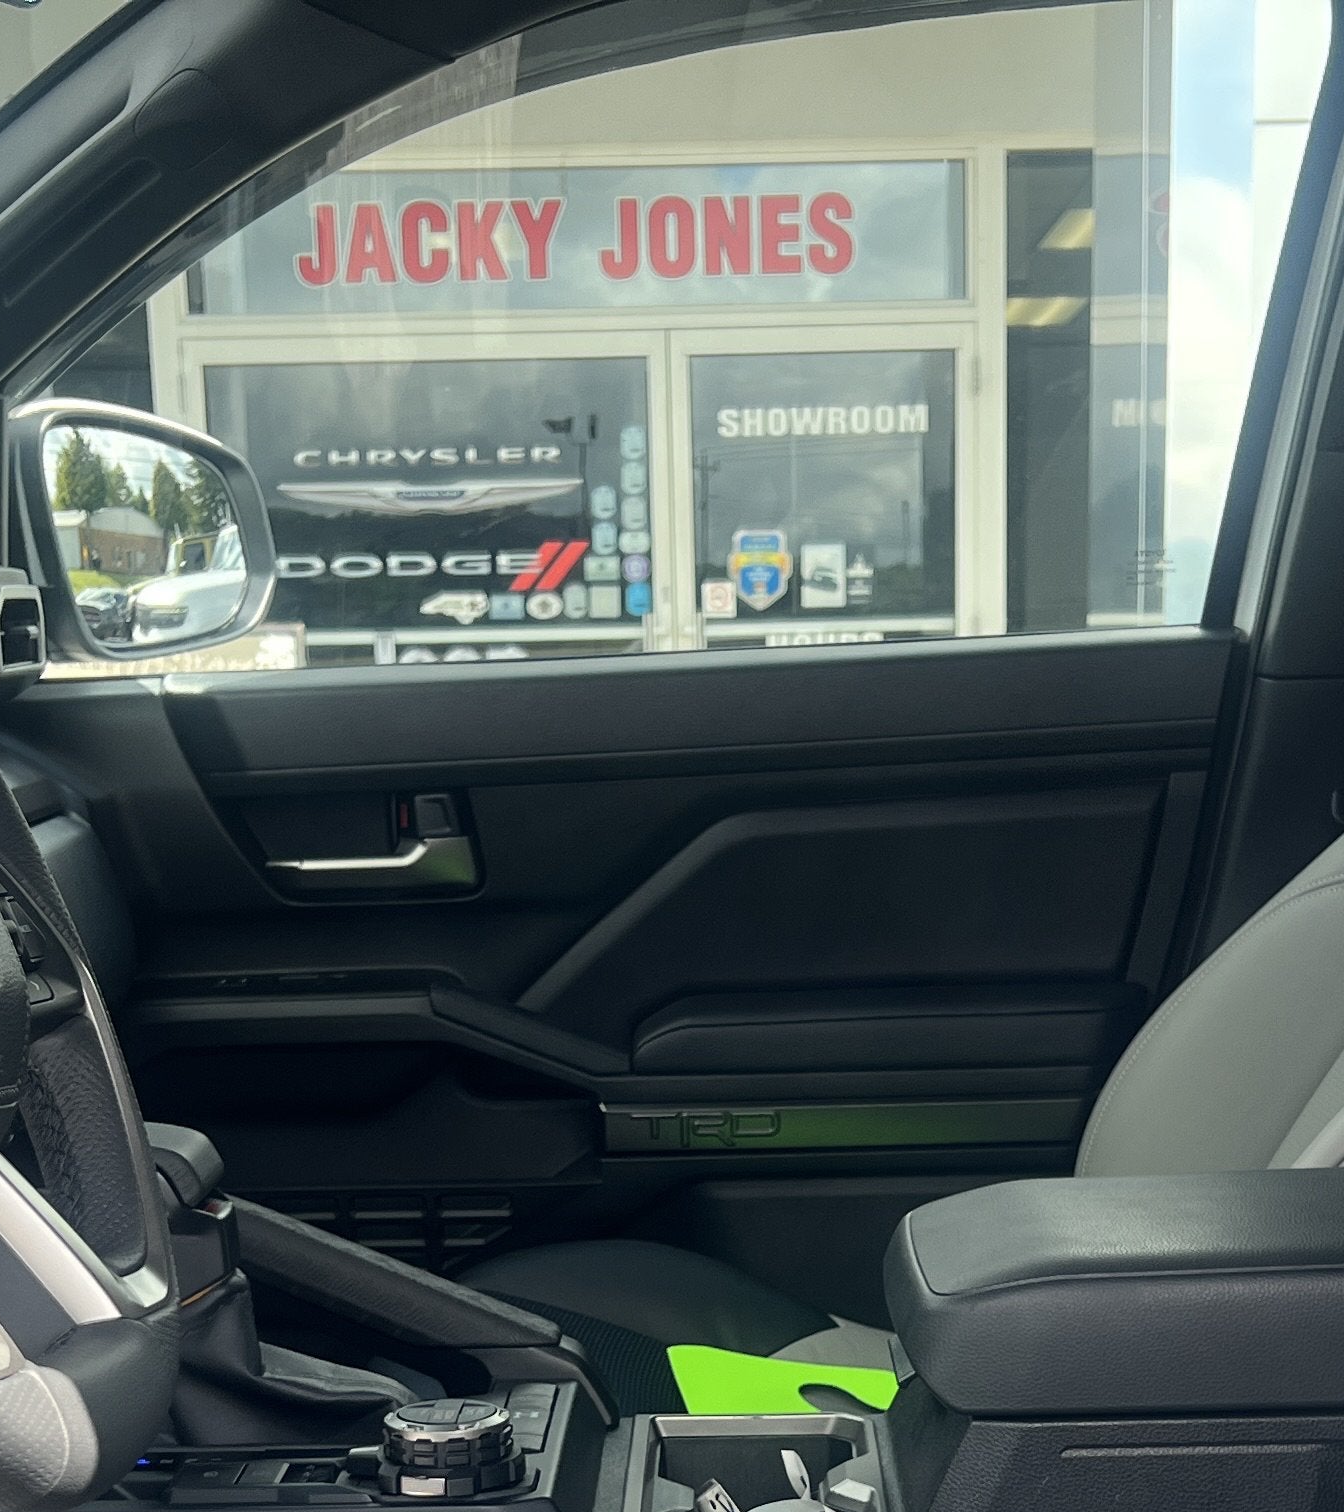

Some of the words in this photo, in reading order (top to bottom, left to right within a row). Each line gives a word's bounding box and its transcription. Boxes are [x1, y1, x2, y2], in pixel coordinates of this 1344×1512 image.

[295, 198, 564, 287] JACKY
[599, 192, 856, 281] JONES
[716, 403, 930, 438] SHOWROOM
[293, 446, 562, 467] CHRYSLER
[275, 551, 544, 580] DODGE
[630, 1111, 782, 1148] TRD
